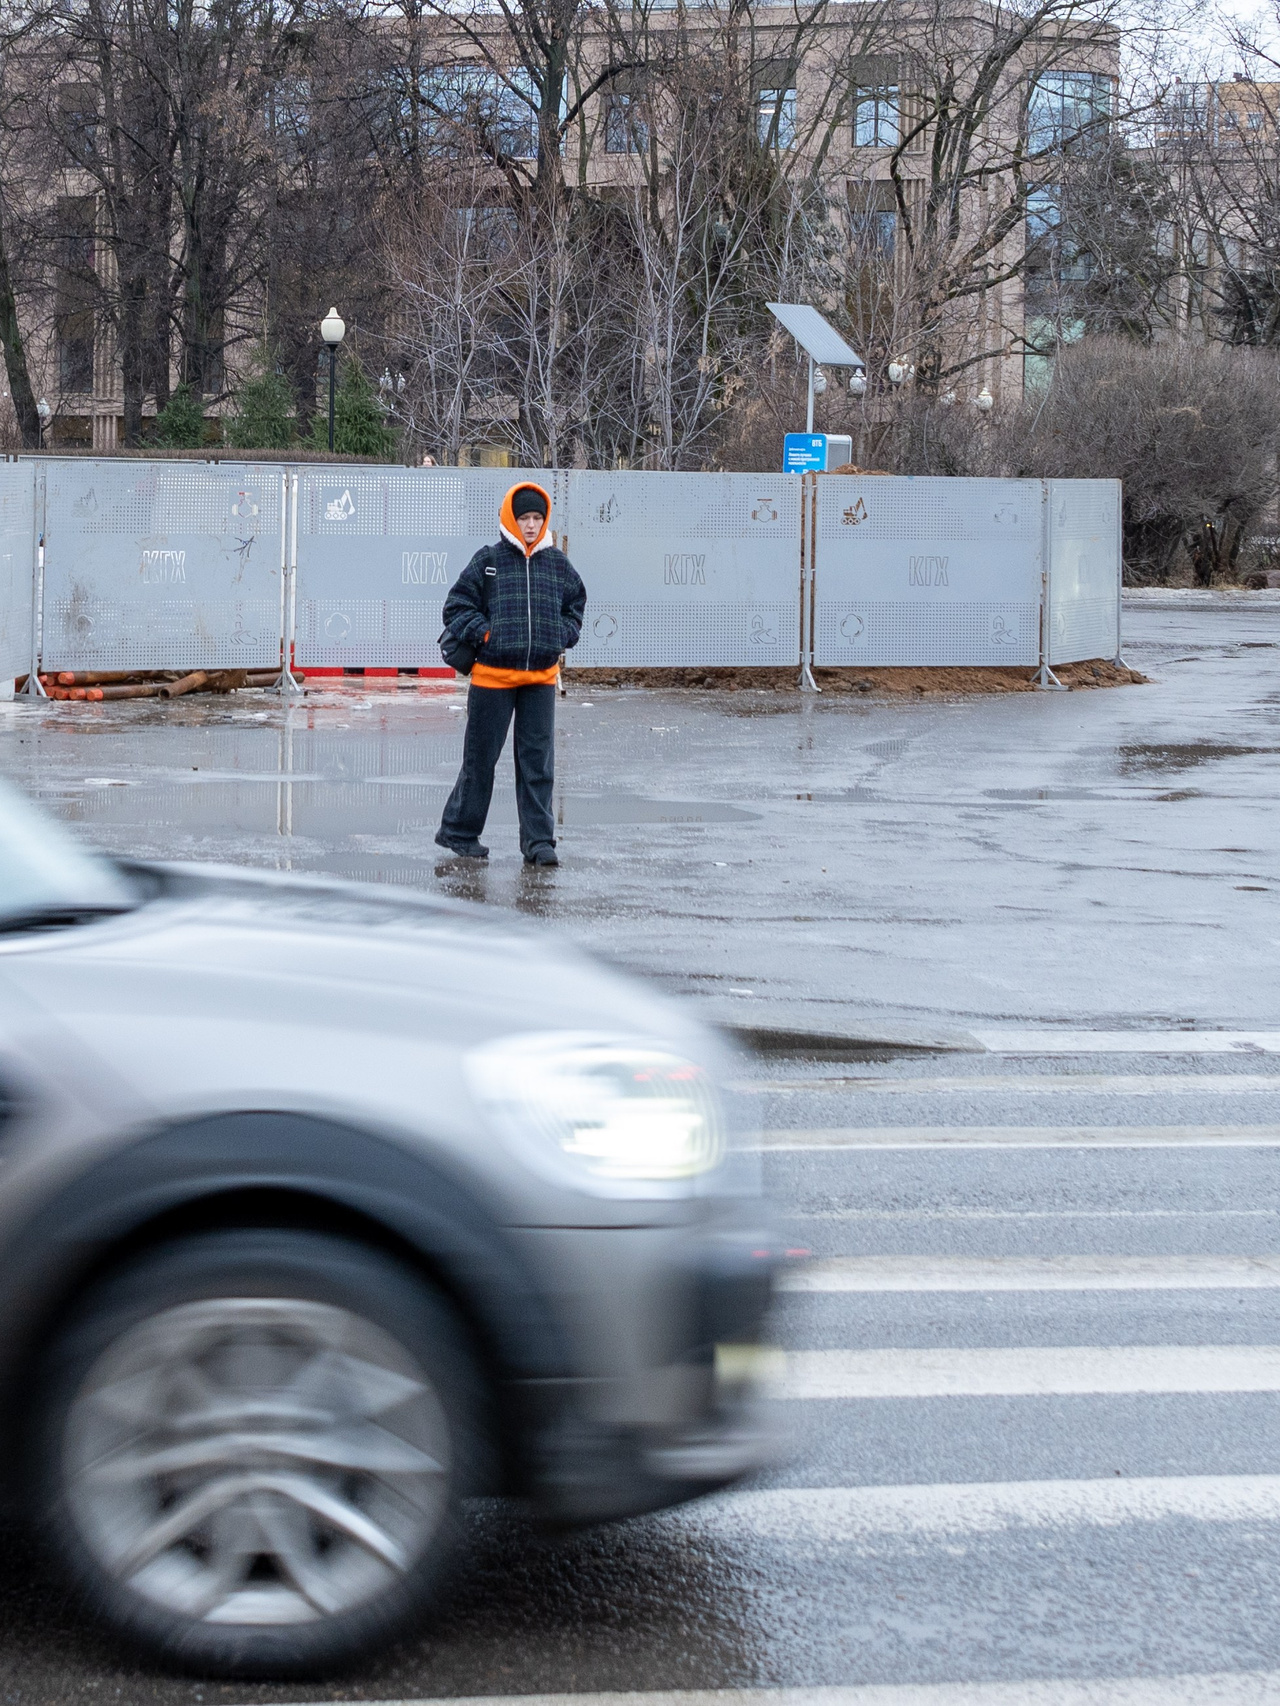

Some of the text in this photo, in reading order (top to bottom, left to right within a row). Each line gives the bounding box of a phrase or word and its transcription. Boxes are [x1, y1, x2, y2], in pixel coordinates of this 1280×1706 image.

[402, 552, 447, 584] КГХ
[664, 554, 705, 585] КГХ
[909, 556, 949, 586] КГХ
